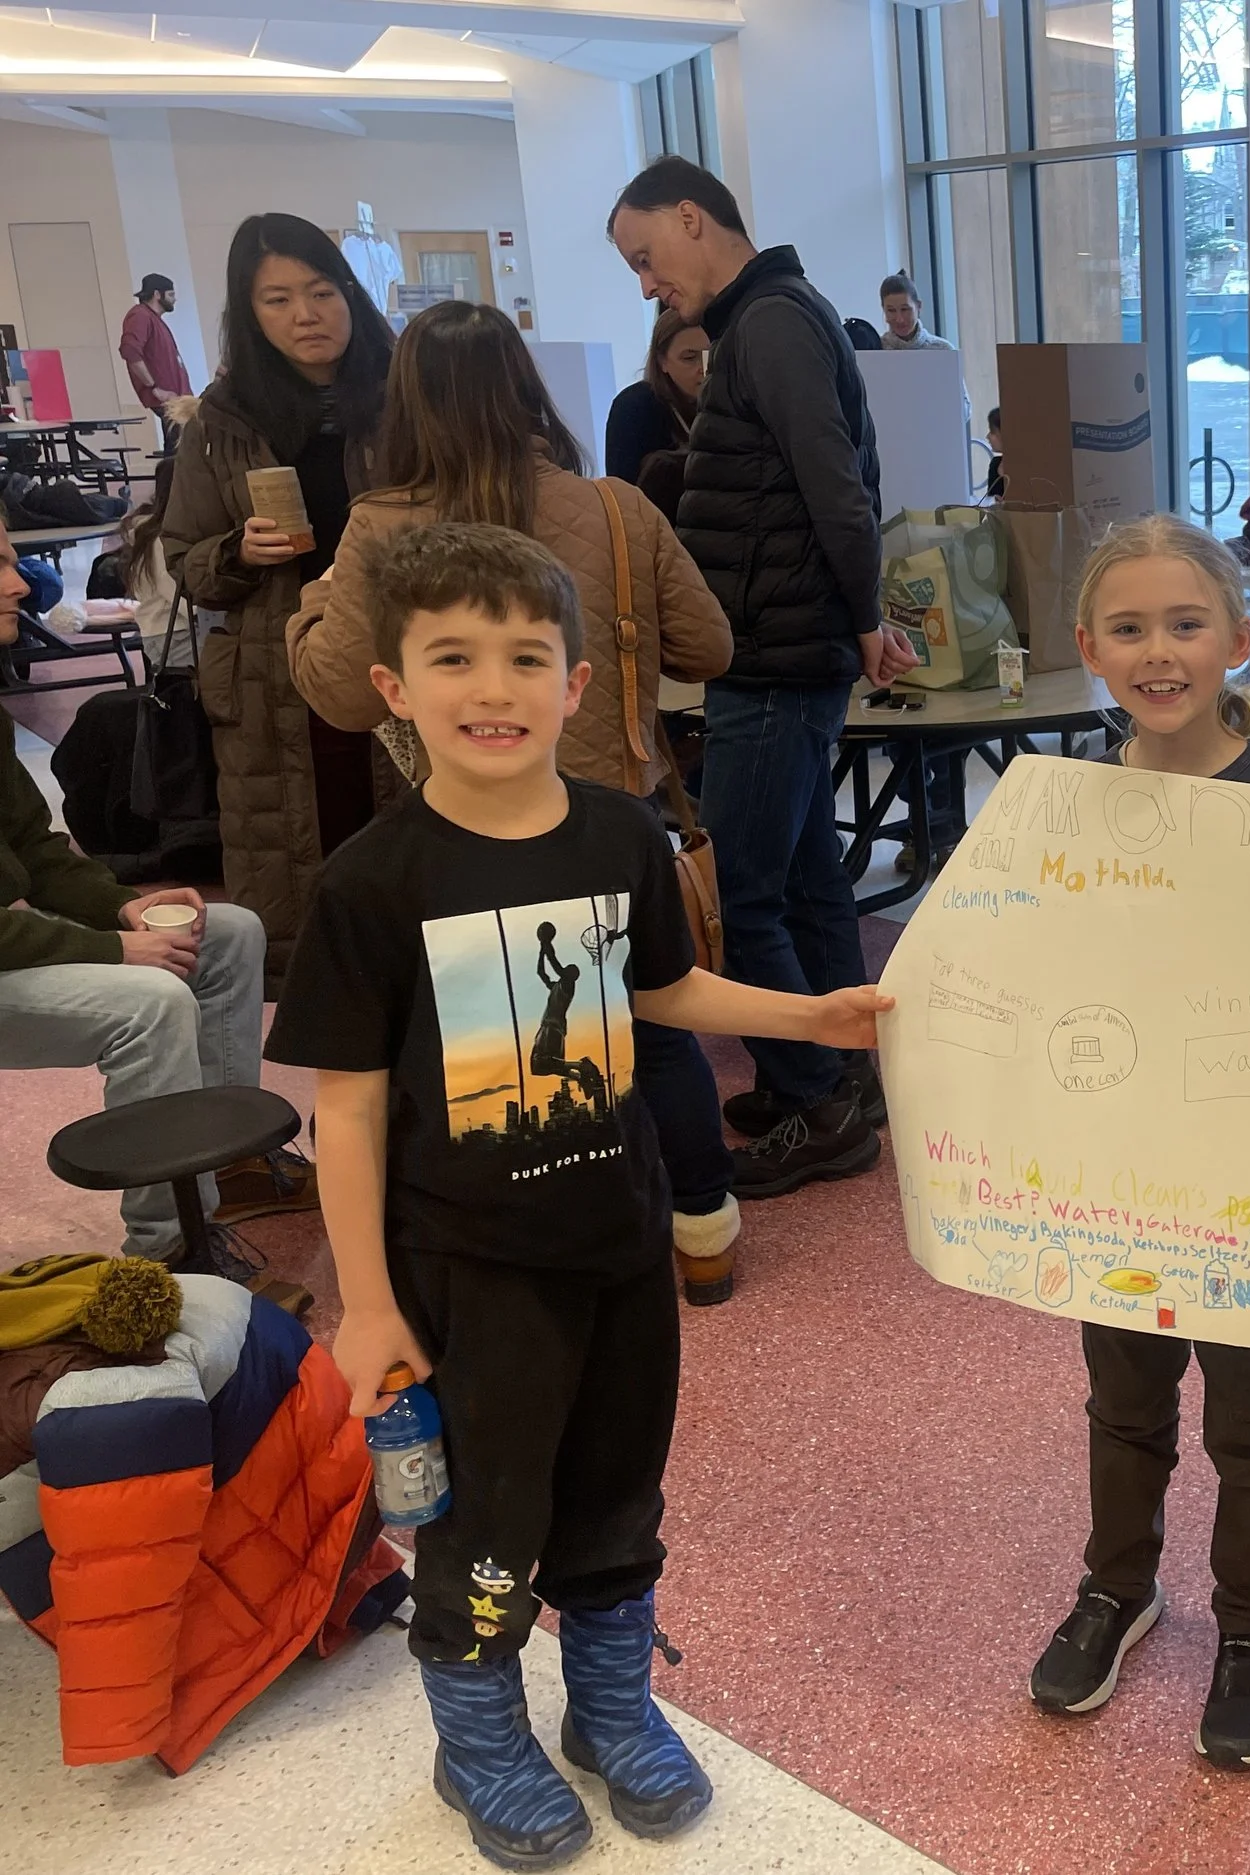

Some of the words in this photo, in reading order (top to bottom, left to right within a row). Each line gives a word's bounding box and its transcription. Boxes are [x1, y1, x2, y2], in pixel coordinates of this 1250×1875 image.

[981, 766, 1084, 837] MAX
[1040, 849, 1177, 892] Mathilda
[511, 1163, 549, 1181] DUNK
[556, 1153, 580, 1169] FOR
[925, 1130, 992, 1169] Which
